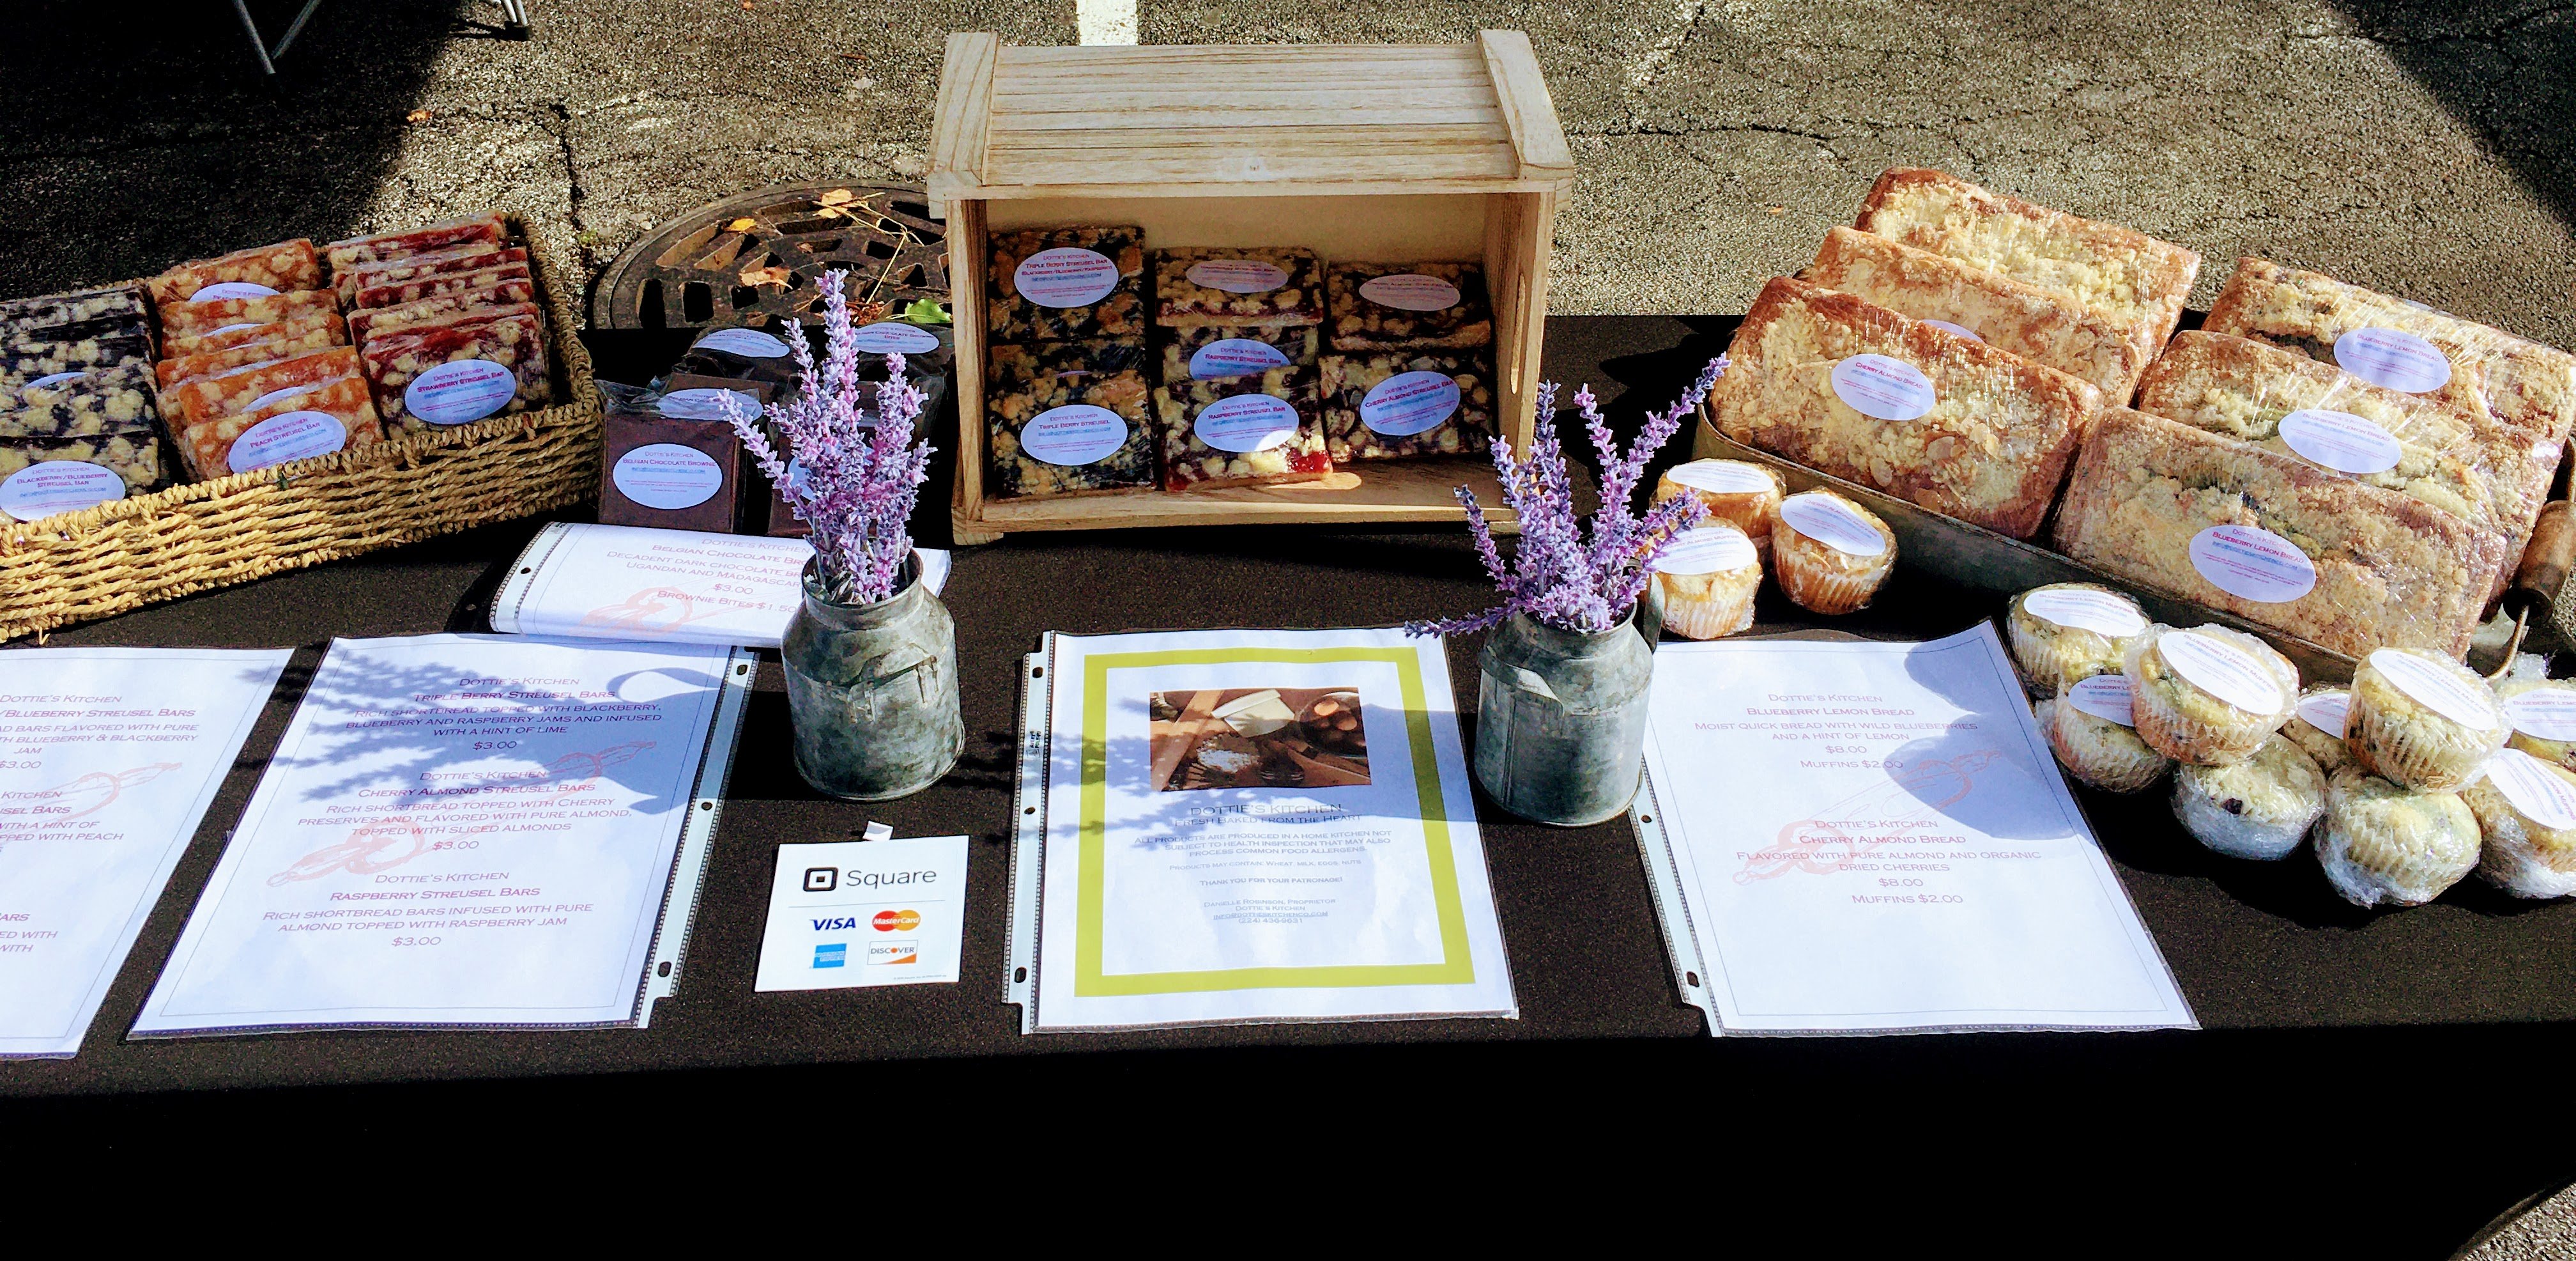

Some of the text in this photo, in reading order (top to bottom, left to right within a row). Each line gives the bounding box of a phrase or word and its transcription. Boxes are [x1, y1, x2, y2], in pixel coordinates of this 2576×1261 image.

[846, 870, 937, 890] Square
[809, 917, 921, 931] VISA MasterCard
[870, 946, 916, 955] DISCOVER
